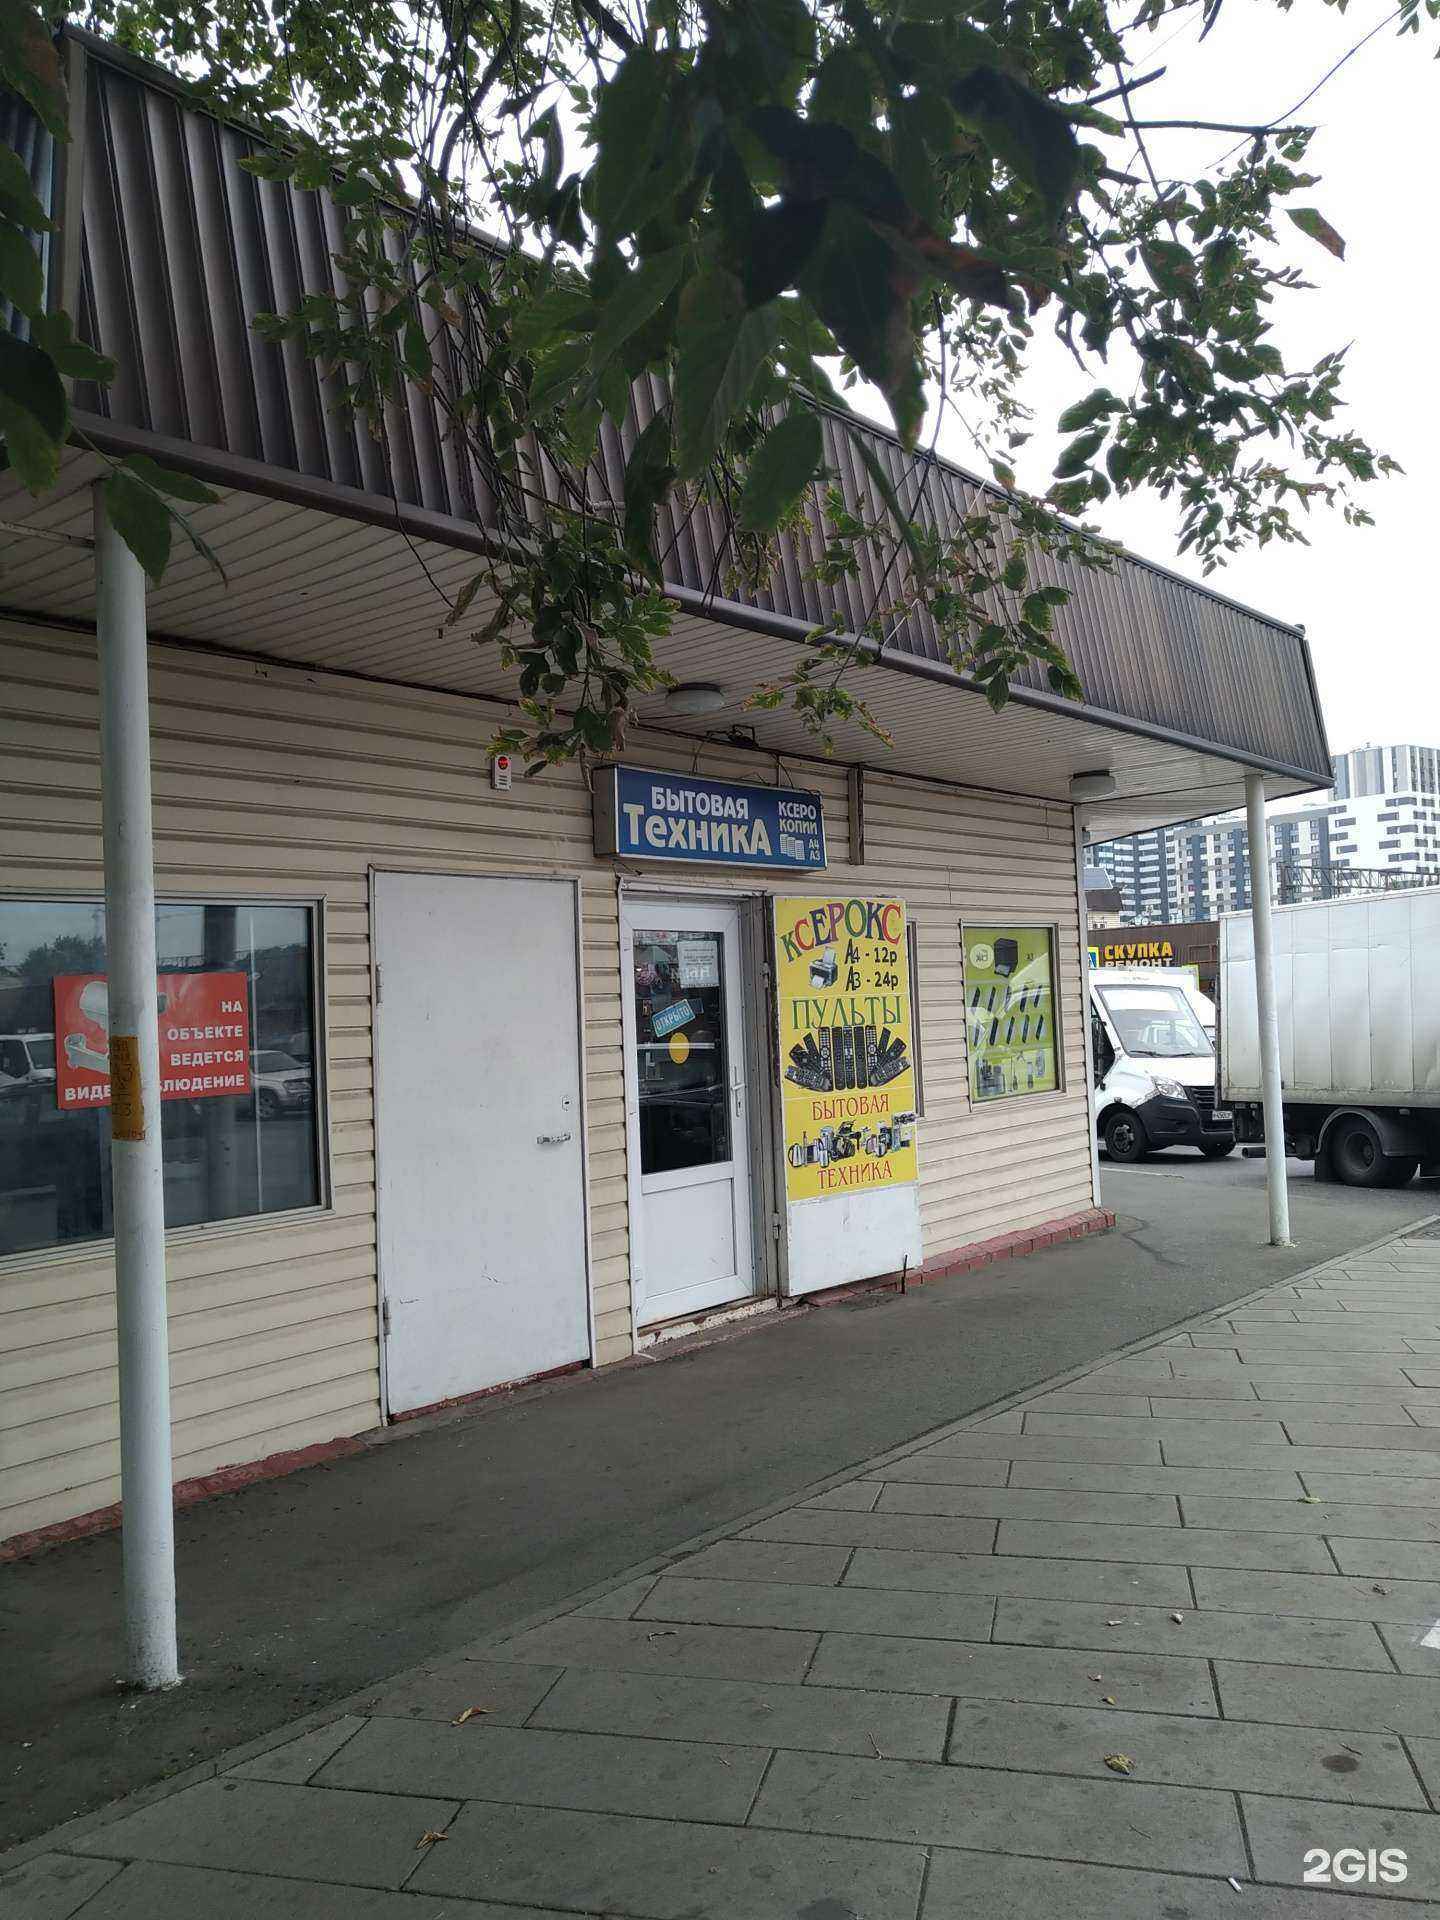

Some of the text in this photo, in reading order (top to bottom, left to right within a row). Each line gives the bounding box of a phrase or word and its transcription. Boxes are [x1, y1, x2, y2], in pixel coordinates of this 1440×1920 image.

[651, 786, 749, 820] БЫТОВАЯ
[778, 801, 817, 820] КСЕРО
[779, 818, 818, 835] КОПИИ
[808, 838, 820, 850] А4
[809, 850, 821, 861] А3
[781, 899, 902, 963] КСЕРОКС
[844, 939, 861, 965] А4
[874, 947, 898, 967] 12р
[1104, 941, 1173, 960] СКУПКА
[845, 966, 861, 992] А3
[874, 971, 899, 991] 24р
[221, 1000, 243, 1013] НА
[654, 1004, 691, 1031] ОТКРЫТО
[792, 995, 903, 1030] ПУЛЬТЫ
[167, 1025, 243, 1041] ОБЪЕКТЕ
[170, 1050, 244, 1067] ВЕДЕТСЯ
[812, 1094, 889, 1121] БЫТОВАЯ
[817, 1160, 893, 1189] ТЕХНИКА
